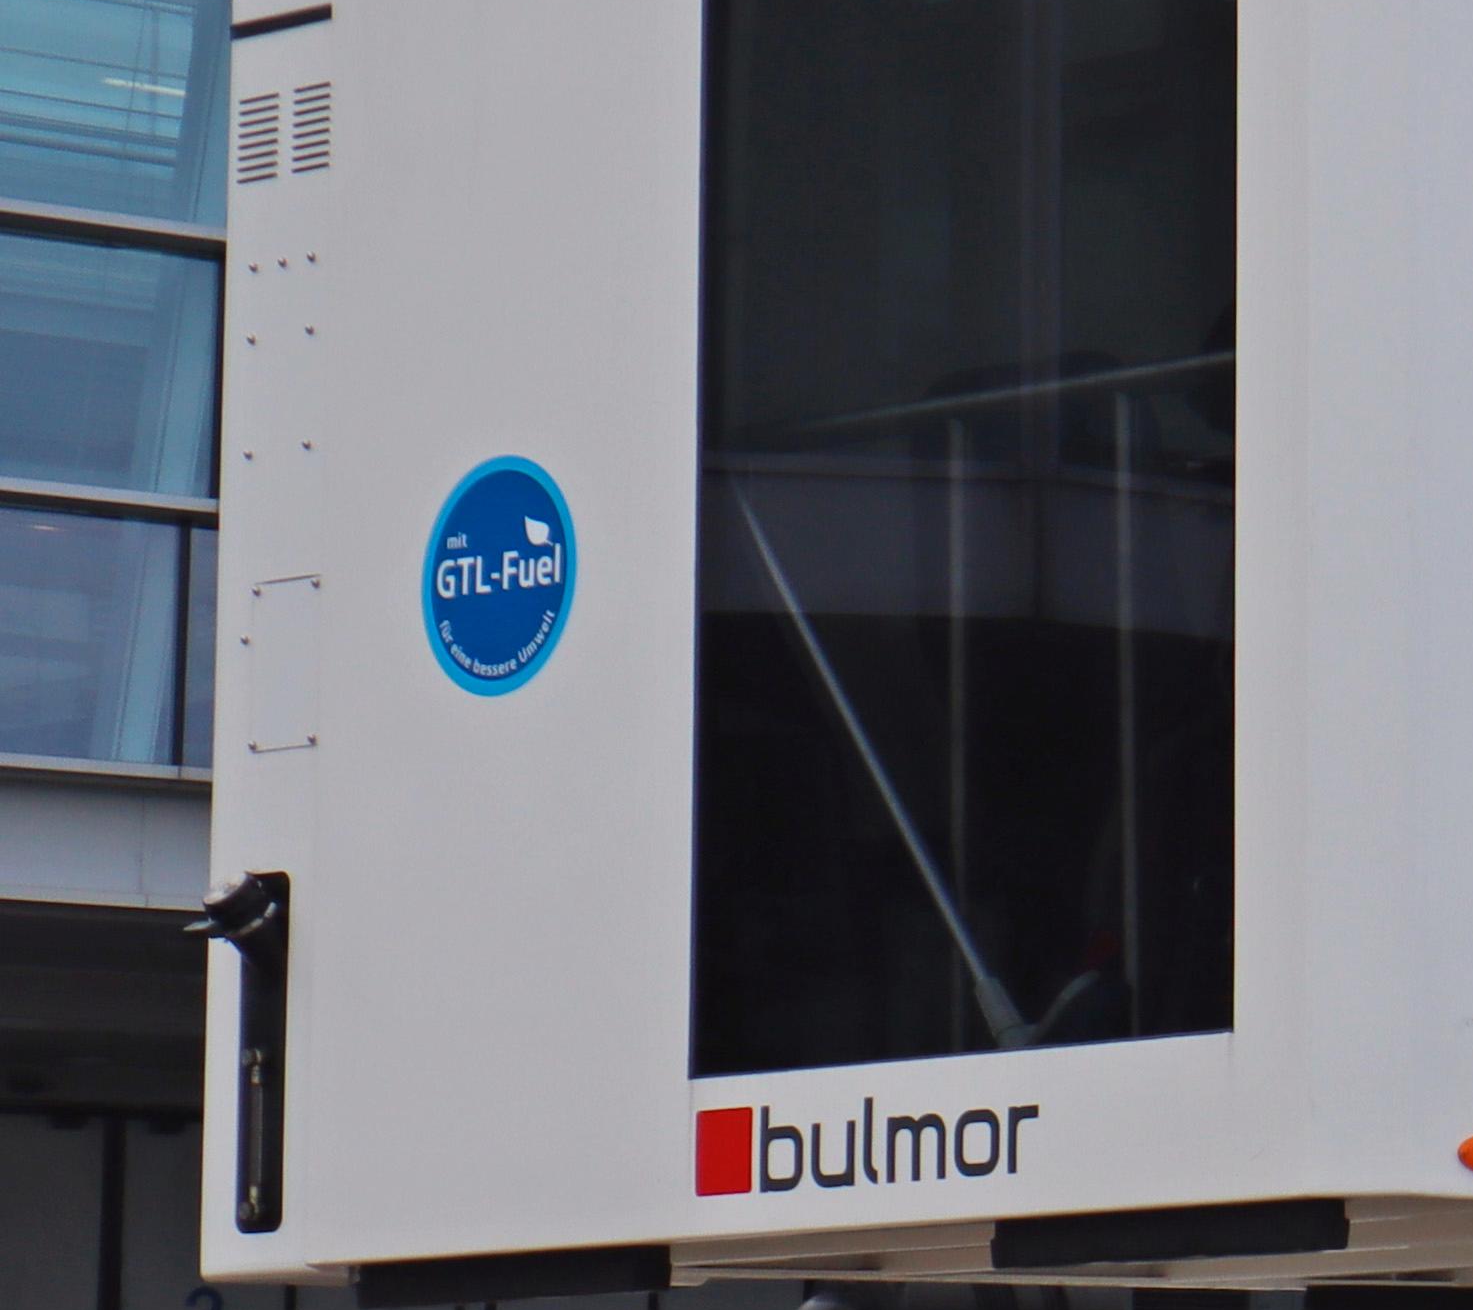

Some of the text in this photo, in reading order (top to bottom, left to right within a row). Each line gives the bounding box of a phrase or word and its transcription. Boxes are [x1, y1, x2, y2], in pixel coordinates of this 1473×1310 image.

[436, 543, 562, 600] GTL-Fuel
[446, 531, 468, 550] mit
[439, 609, 556, 677] für eine bessere Umwelt
[758, 1095, 1040, 1194] bulmor
